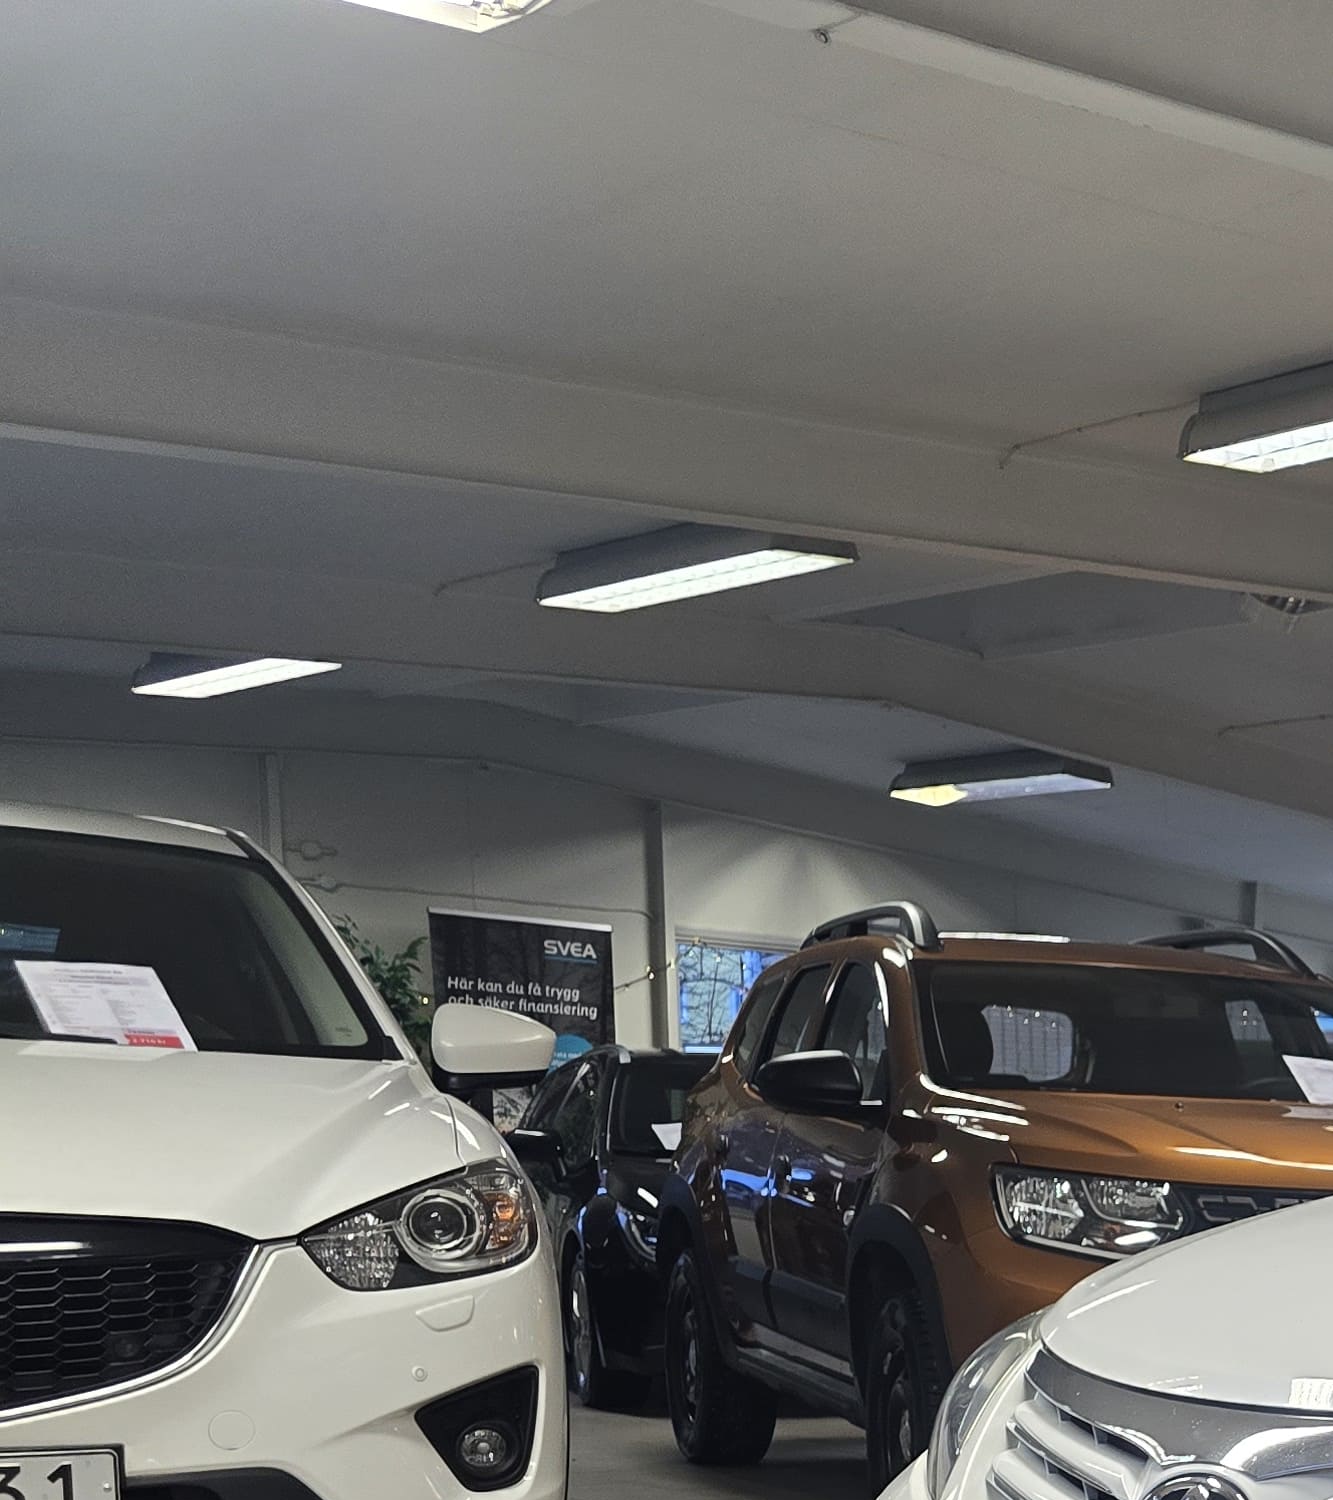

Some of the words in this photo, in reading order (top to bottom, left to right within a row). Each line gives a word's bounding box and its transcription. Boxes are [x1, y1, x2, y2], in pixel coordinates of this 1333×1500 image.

[544, 939, 597, 959] SVEA
[447, 975, 474, 990] Här
[477, 977, 503, 993] kan
[506, 980, 525, 995] du
[527, 982, 542, 997] få
[545, 984, 580, 1002] trygg
[518, 998, 598, 1020] finansiering
